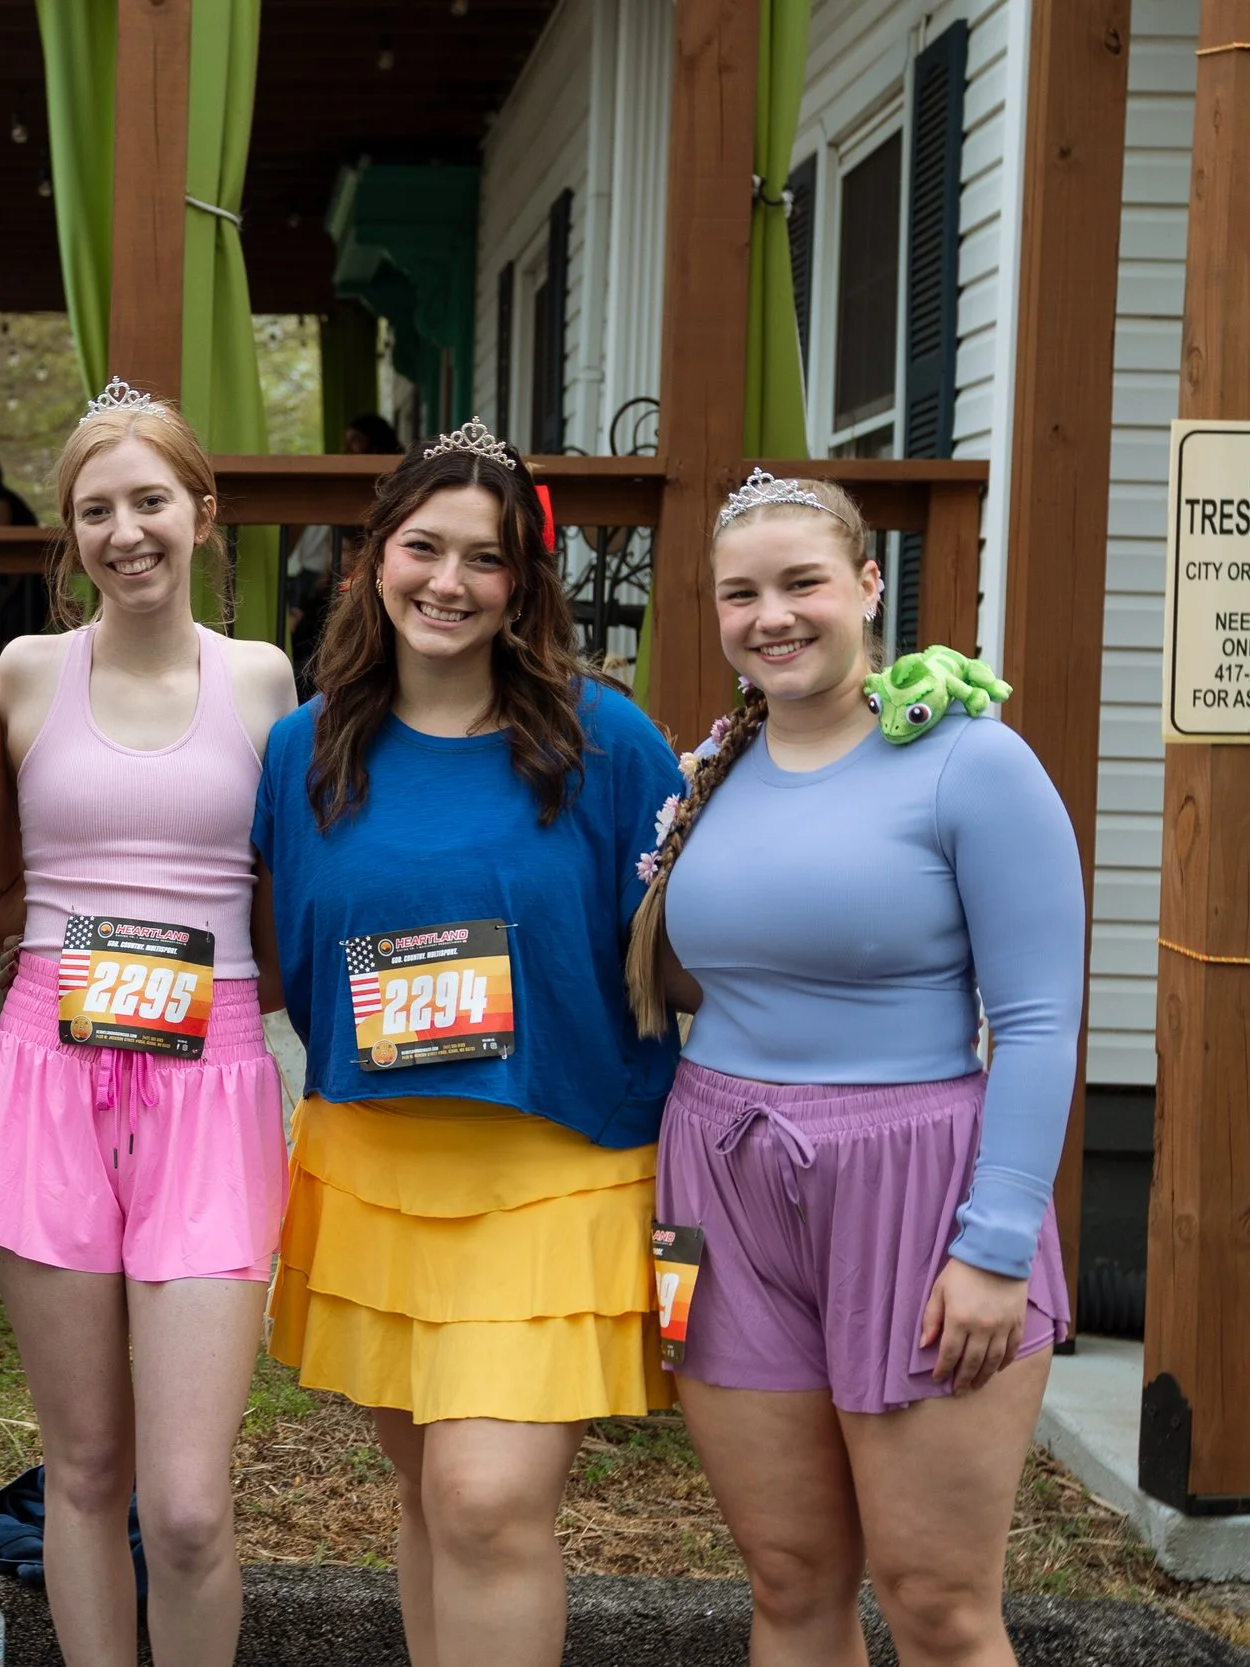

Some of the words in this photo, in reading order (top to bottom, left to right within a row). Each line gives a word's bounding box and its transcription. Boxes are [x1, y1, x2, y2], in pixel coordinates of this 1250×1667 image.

[1186, 561, 1223, 581] CITY
[1222, 638, 1250, 657] ON
[1193, 689, 1228, 708] FOR
[115, 924, 189, 943] HEARTLAND
[395, 929, 469, 949] HEARTLAND
[82, 961, 198, 1024] 2295
[382, 969, 487, 1035] 2294
